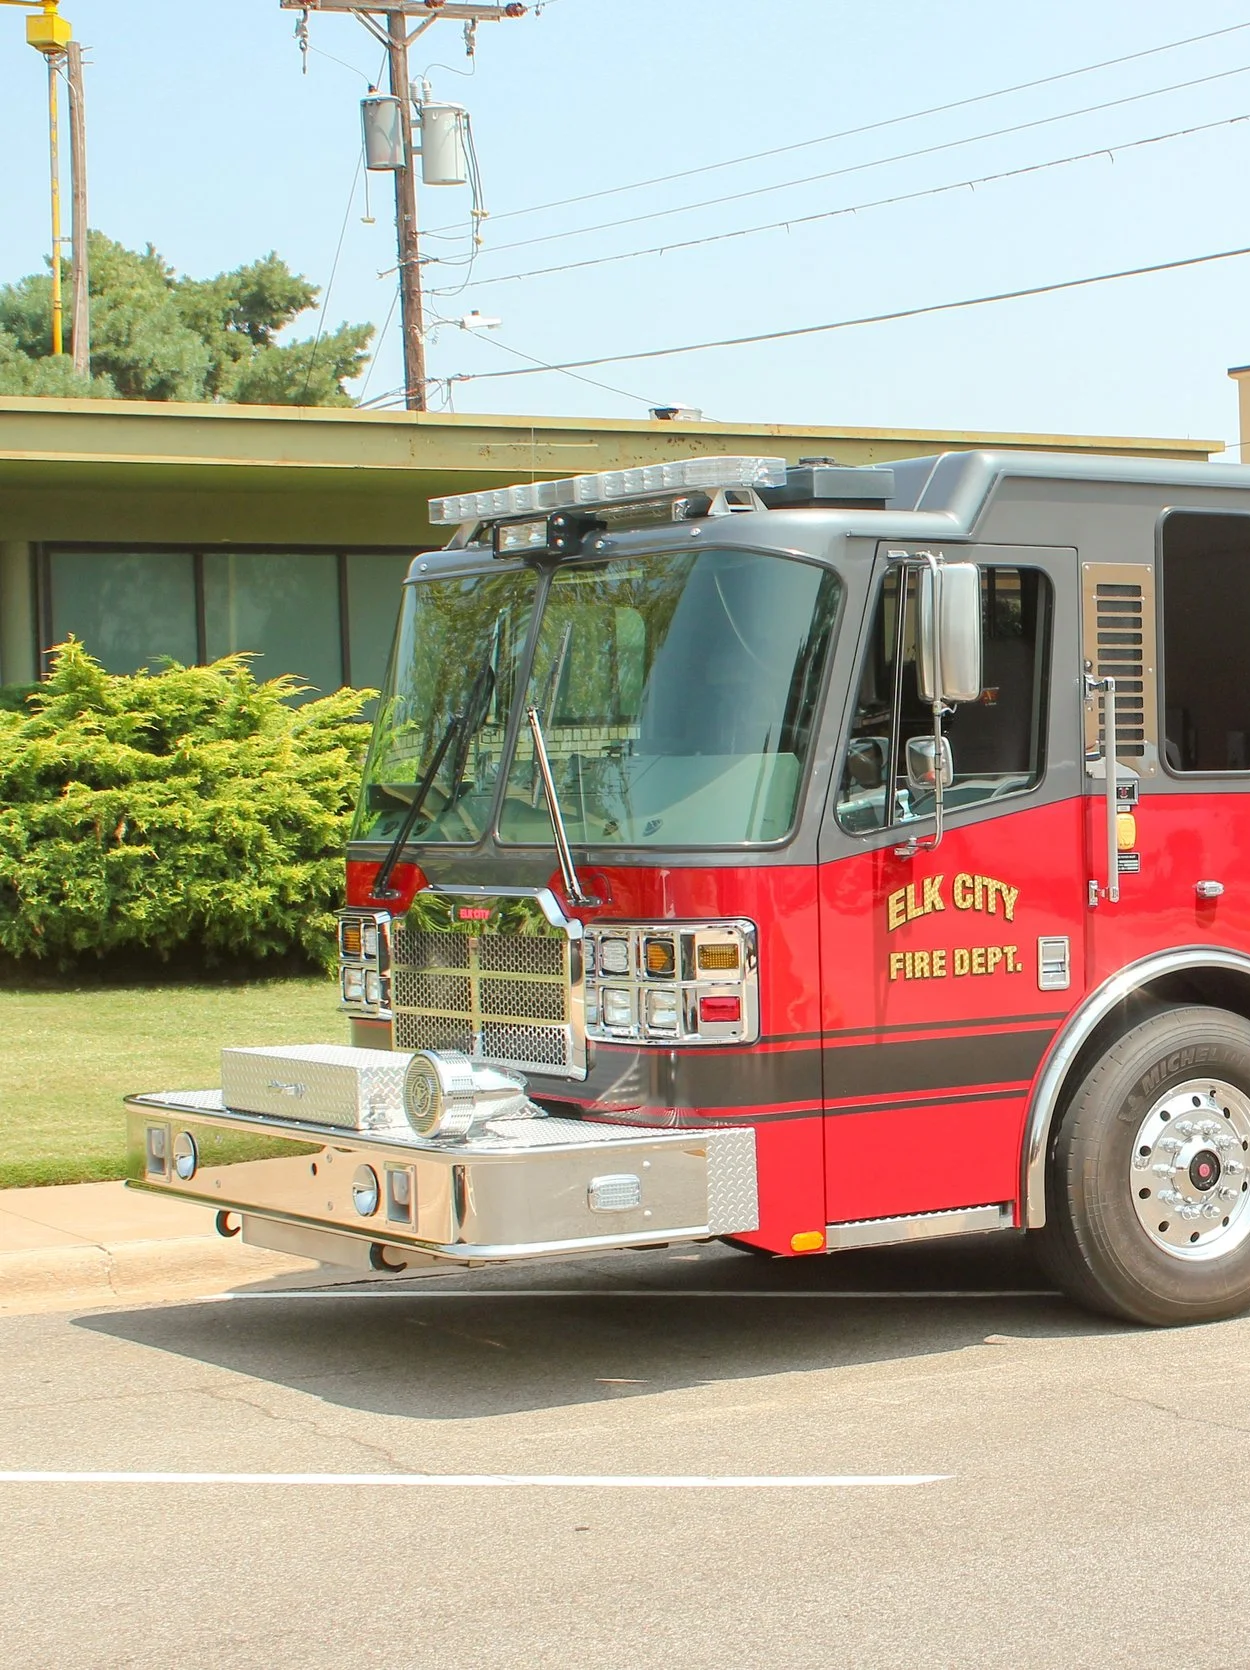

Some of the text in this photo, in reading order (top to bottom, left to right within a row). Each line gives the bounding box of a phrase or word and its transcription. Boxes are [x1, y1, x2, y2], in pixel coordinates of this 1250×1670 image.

[887, 872, 1019, 933] ELK CITY
[889, 944, 1023, 981] FIRE DEPT.
